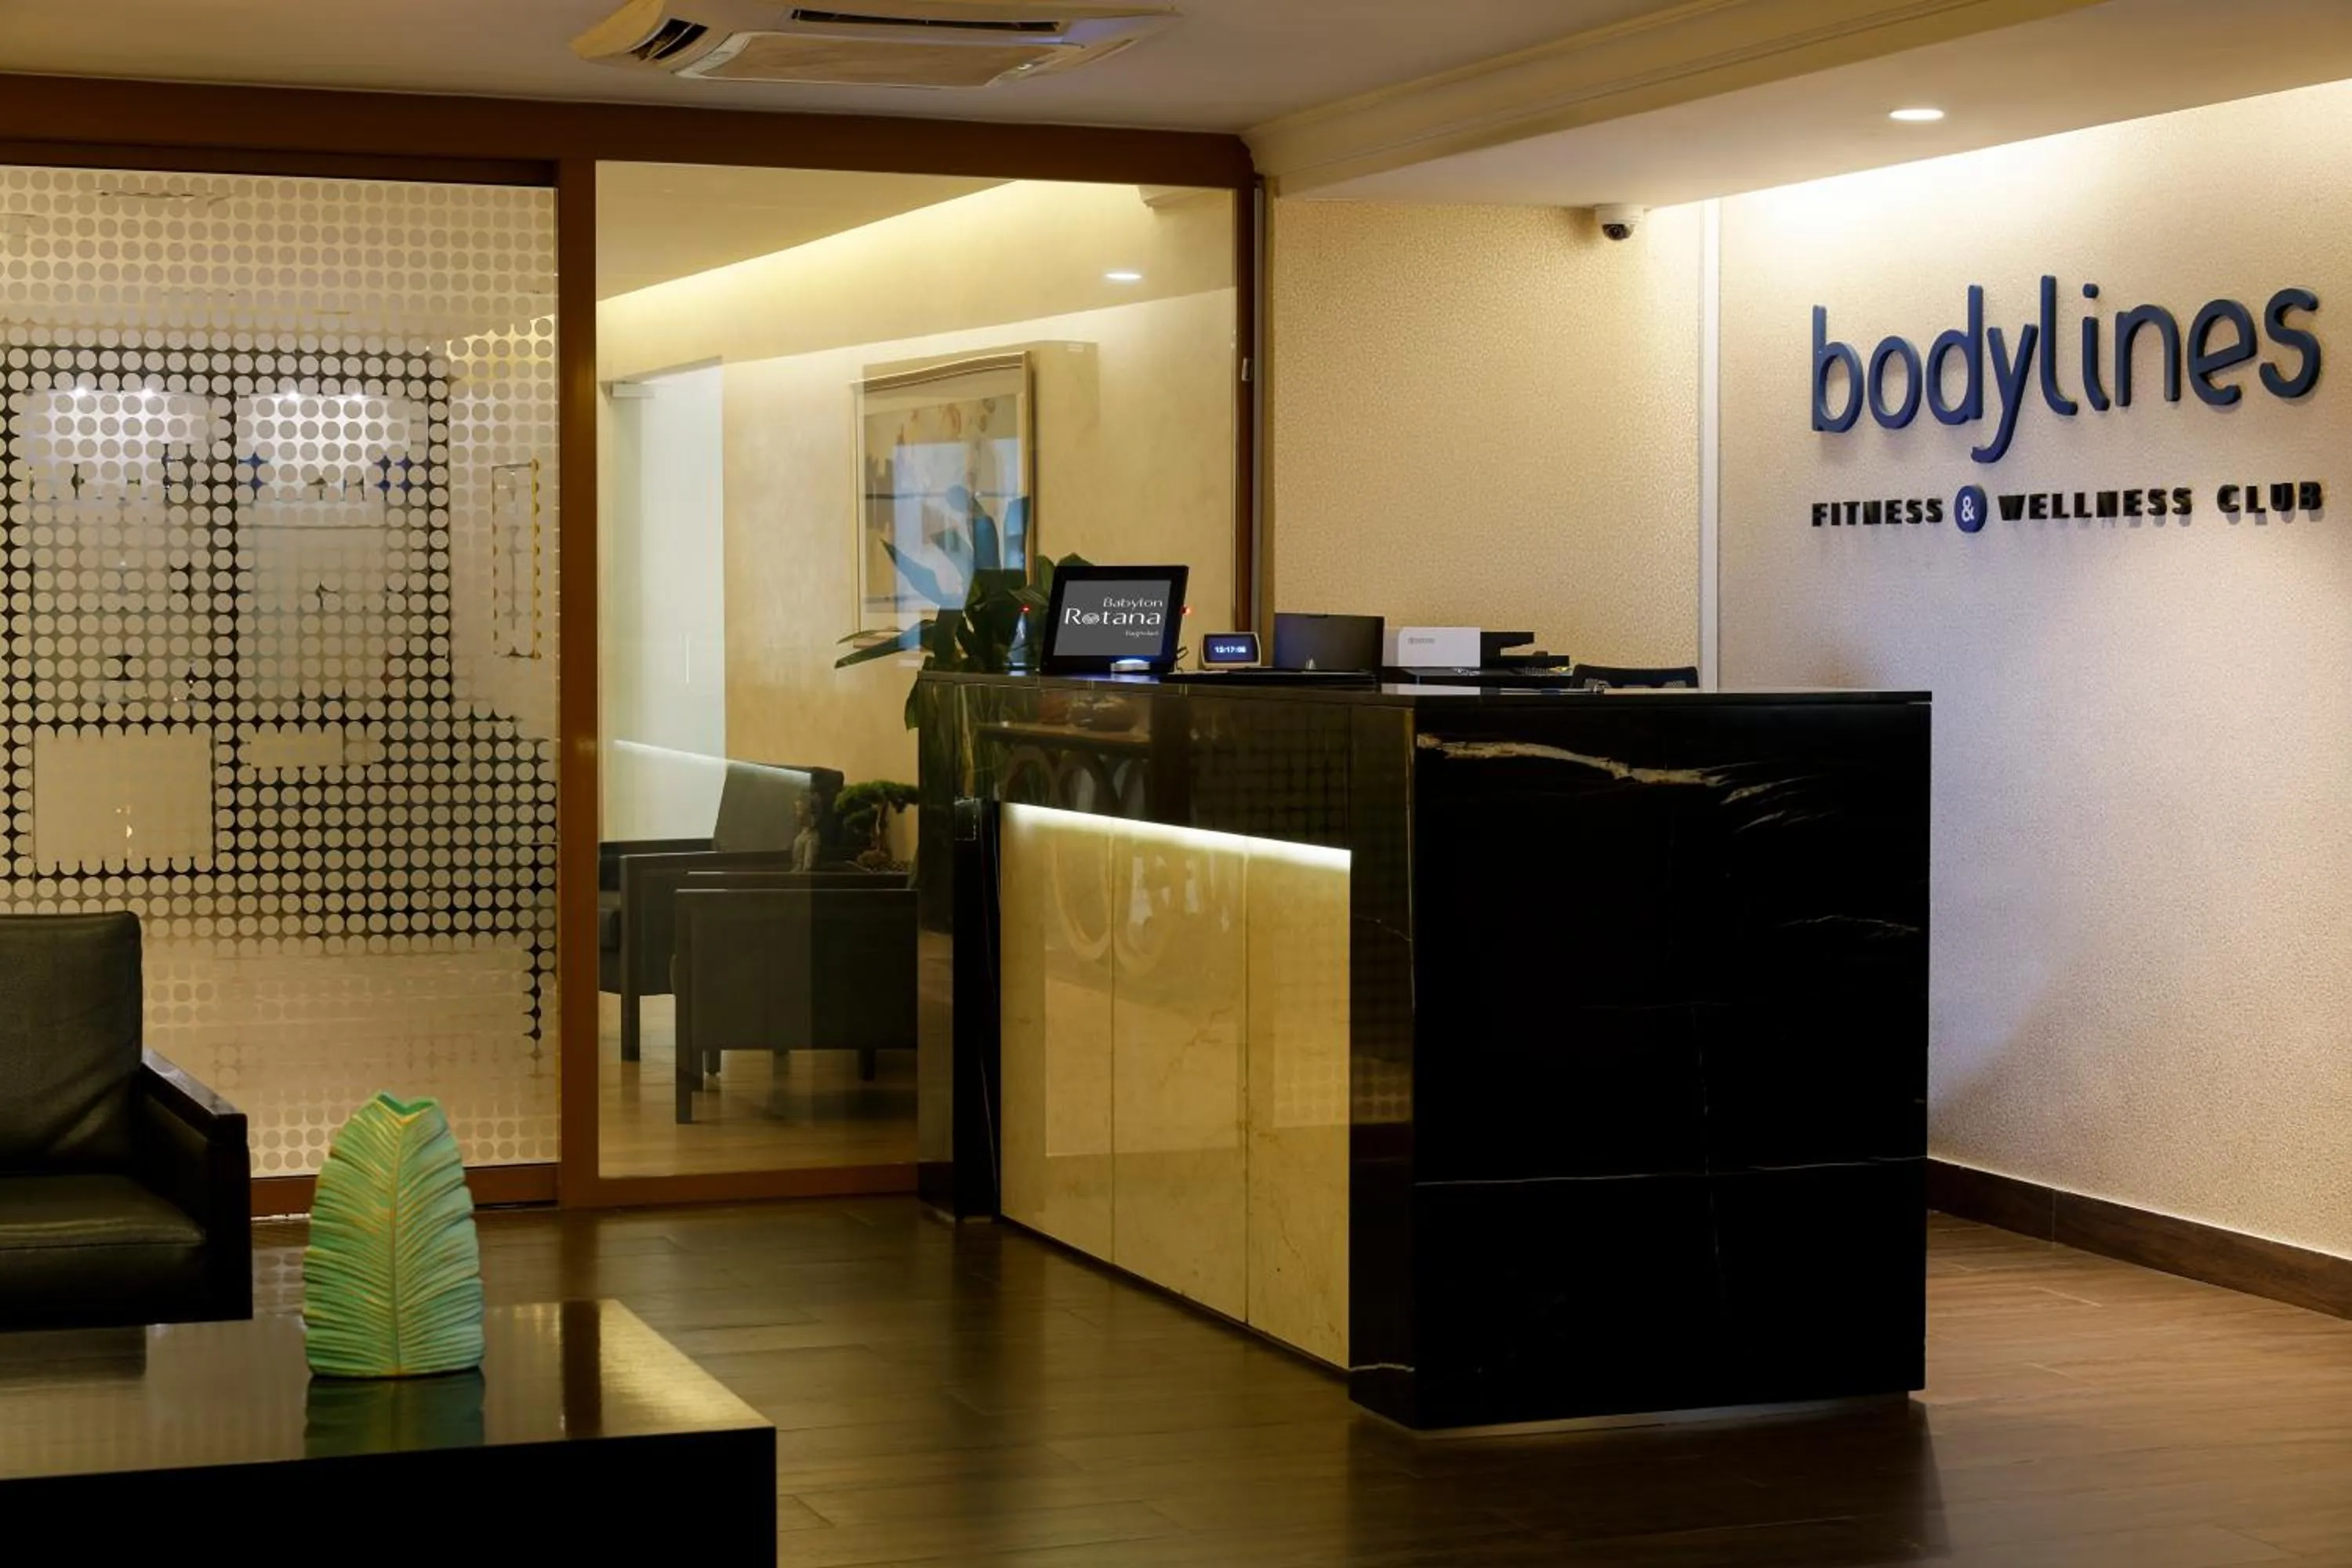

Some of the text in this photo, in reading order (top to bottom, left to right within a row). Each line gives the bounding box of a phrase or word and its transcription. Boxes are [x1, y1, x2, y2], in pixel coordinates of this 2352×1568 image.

[1811, 274, 2321, 463] bodylines
[1812, 498, 1943, 527] FITNESS
[1998, 487, 2193, 521] WELLNESS
[2216, 481, 2323, 514] CLUB
[1065, 608, 1160, 625] Rotana
[1102, 597, 1163, 609] Babylon
